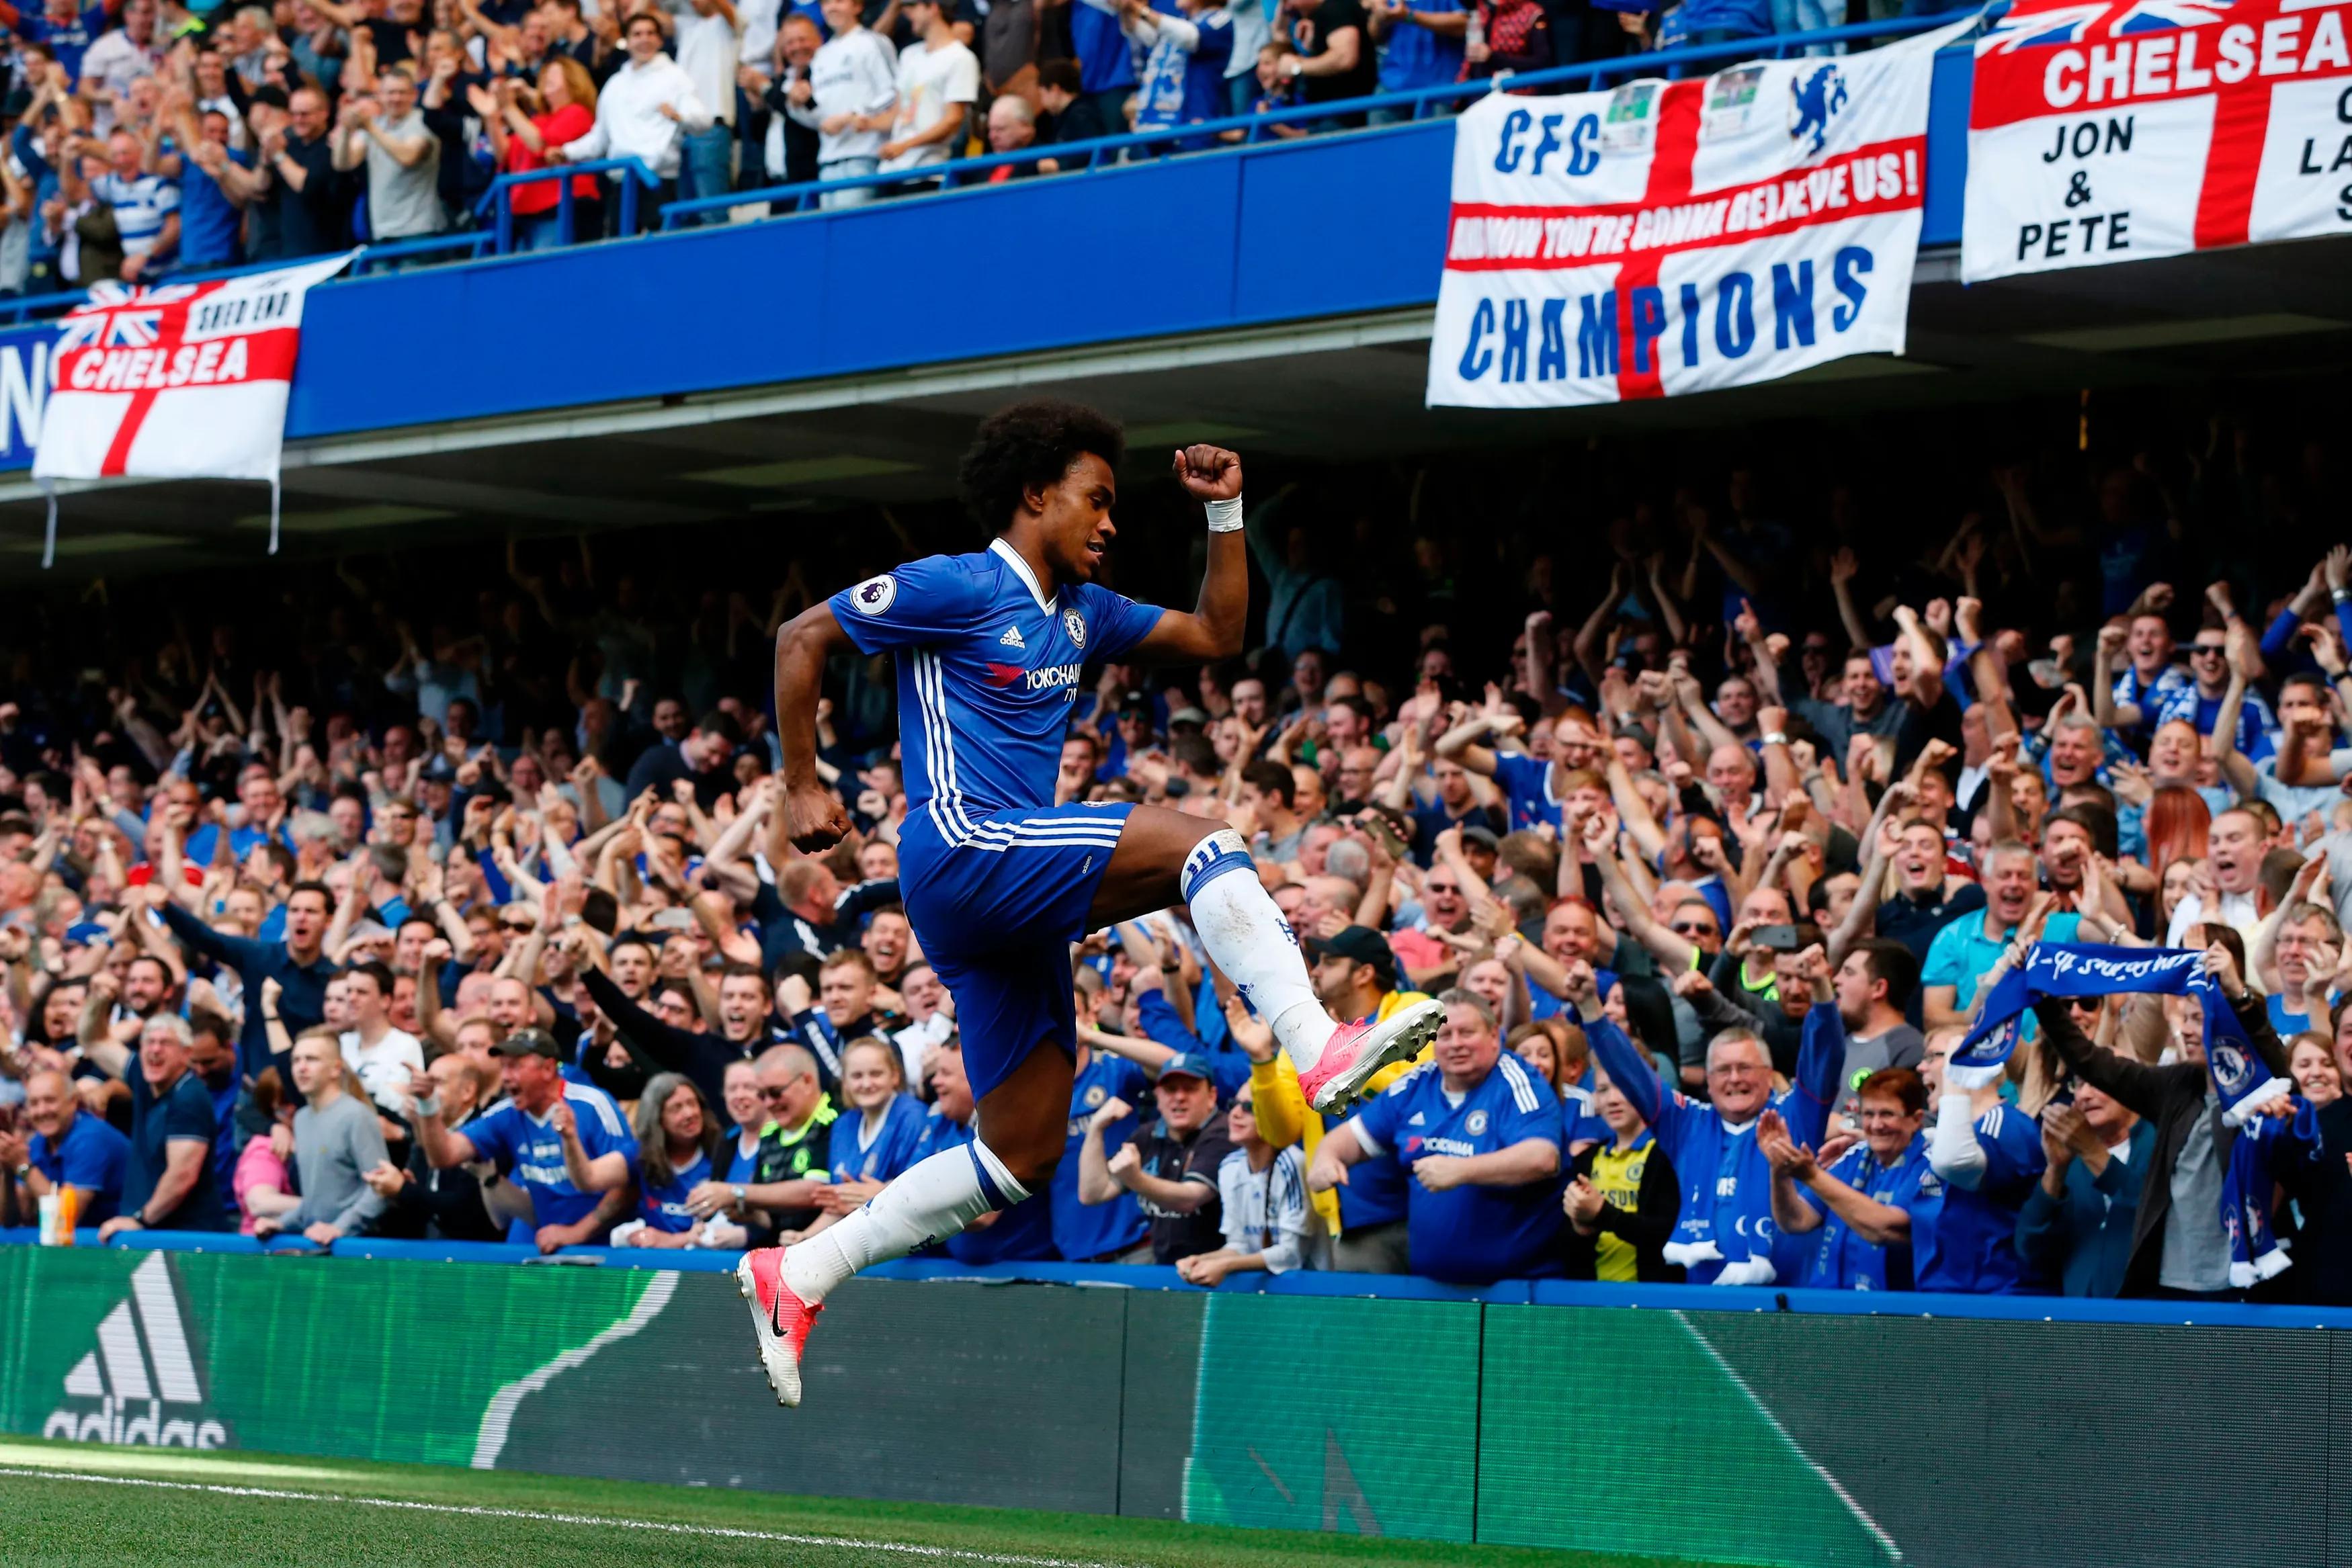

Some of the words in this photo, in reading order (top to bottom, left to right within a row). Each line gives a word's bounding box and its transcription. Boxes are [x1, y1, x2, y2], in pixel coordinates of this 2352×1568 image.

[2043, 10, 2351, 109] CHELSEA
[1494, 108, 1601, 177] CFC
[2043, 115, 2134, 163] JON
[1486, 214, 1545, 259] NOW
[1543, 212, 1634, 259] YOU'RE
[1629, 198, 1731, 252] GONNA
[1726, 164, 1849, 233] BELIEVE
[1850, 148, 1919, 204] US!
[2065, 170, 2092, 208] &
[2018, 211, 2131, 261] PETE
[198, 298, 249, 332] SHED
[253, 291, 290, 322] END
[1458, 246, 1874, 384] CHAMPIONS
[71, 338, 248, 390] CHELSEA
[999, 637, 1025, 649] adidas
[1083, 856, 1092, 873] adizero
[43, 1394, 227, 1450] adidas
